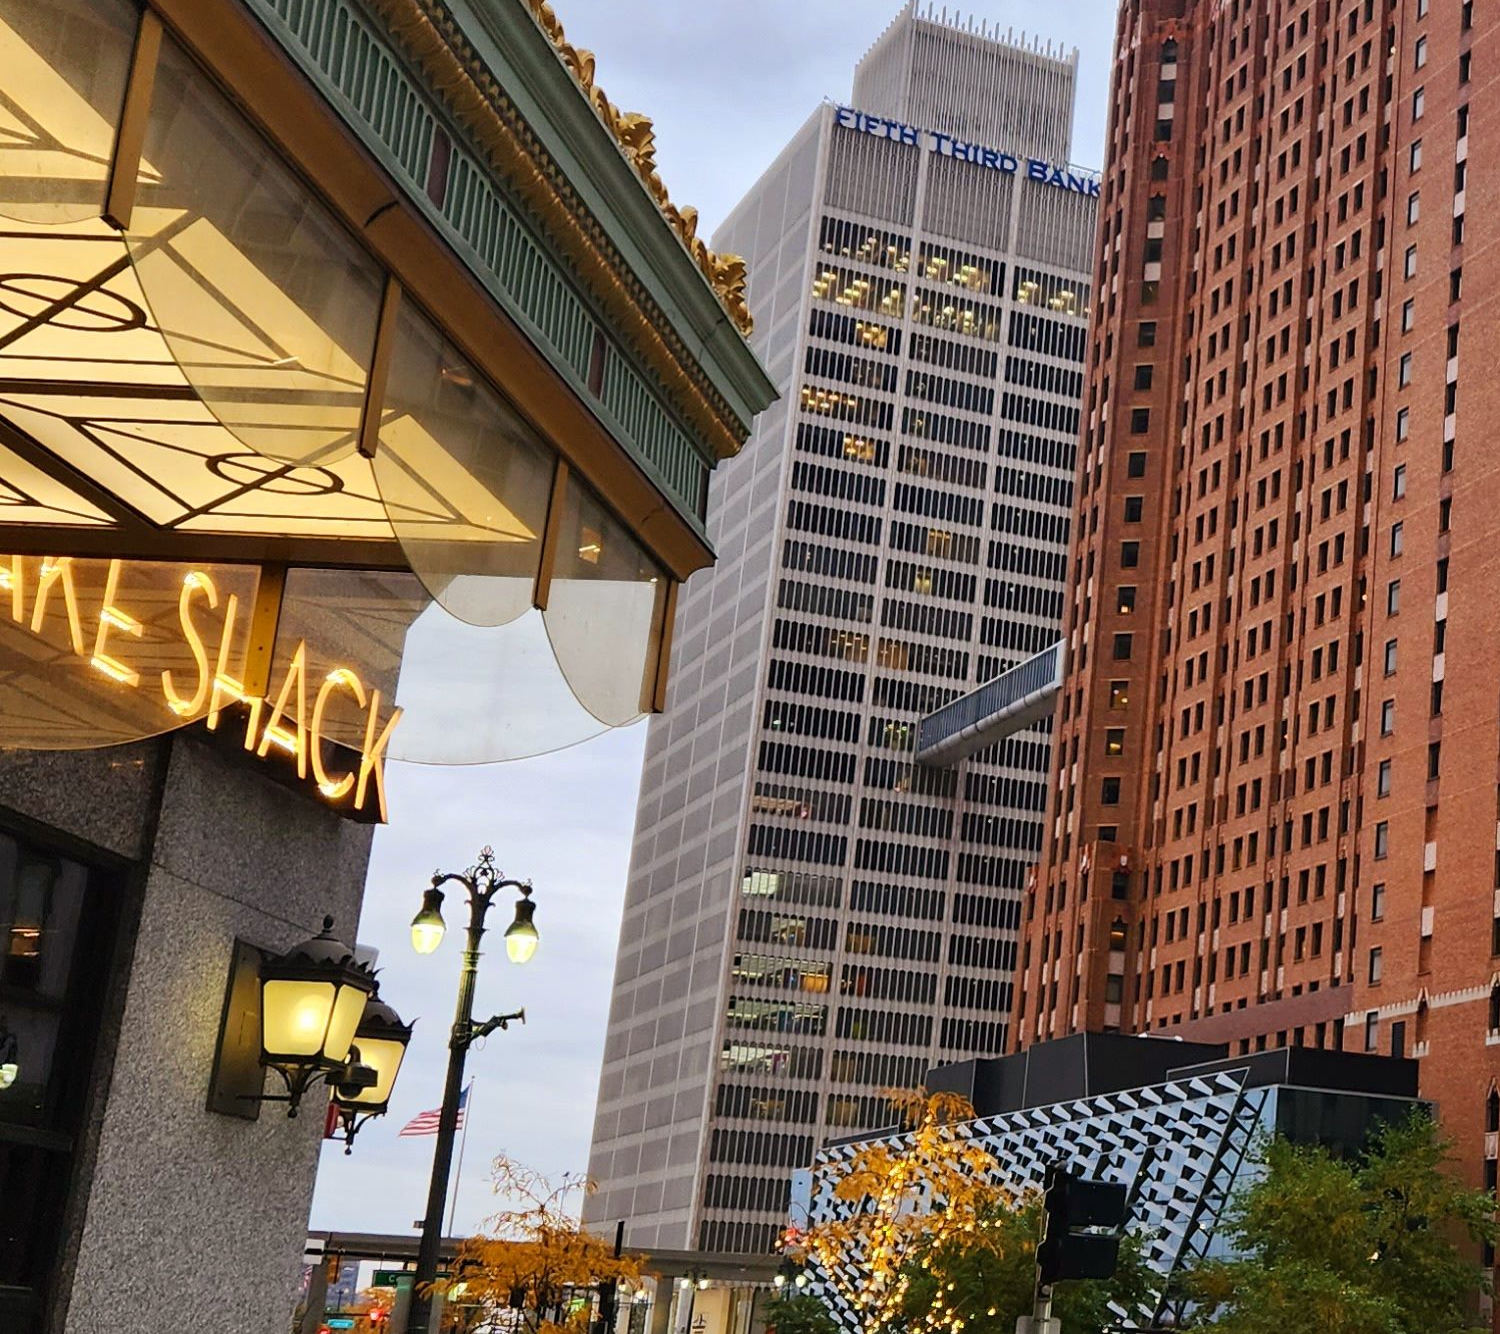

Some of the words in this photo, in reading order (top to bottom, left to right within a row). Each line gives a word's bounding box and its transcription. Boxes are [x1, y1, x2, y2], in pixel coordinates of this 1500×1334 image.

[836, 107, 918, 147] FIFTH
[931, 131, 1018, 174] THIRD
[1027, 159, 1101, 198] BANK
[162, 571, 404, 824] SHACK
